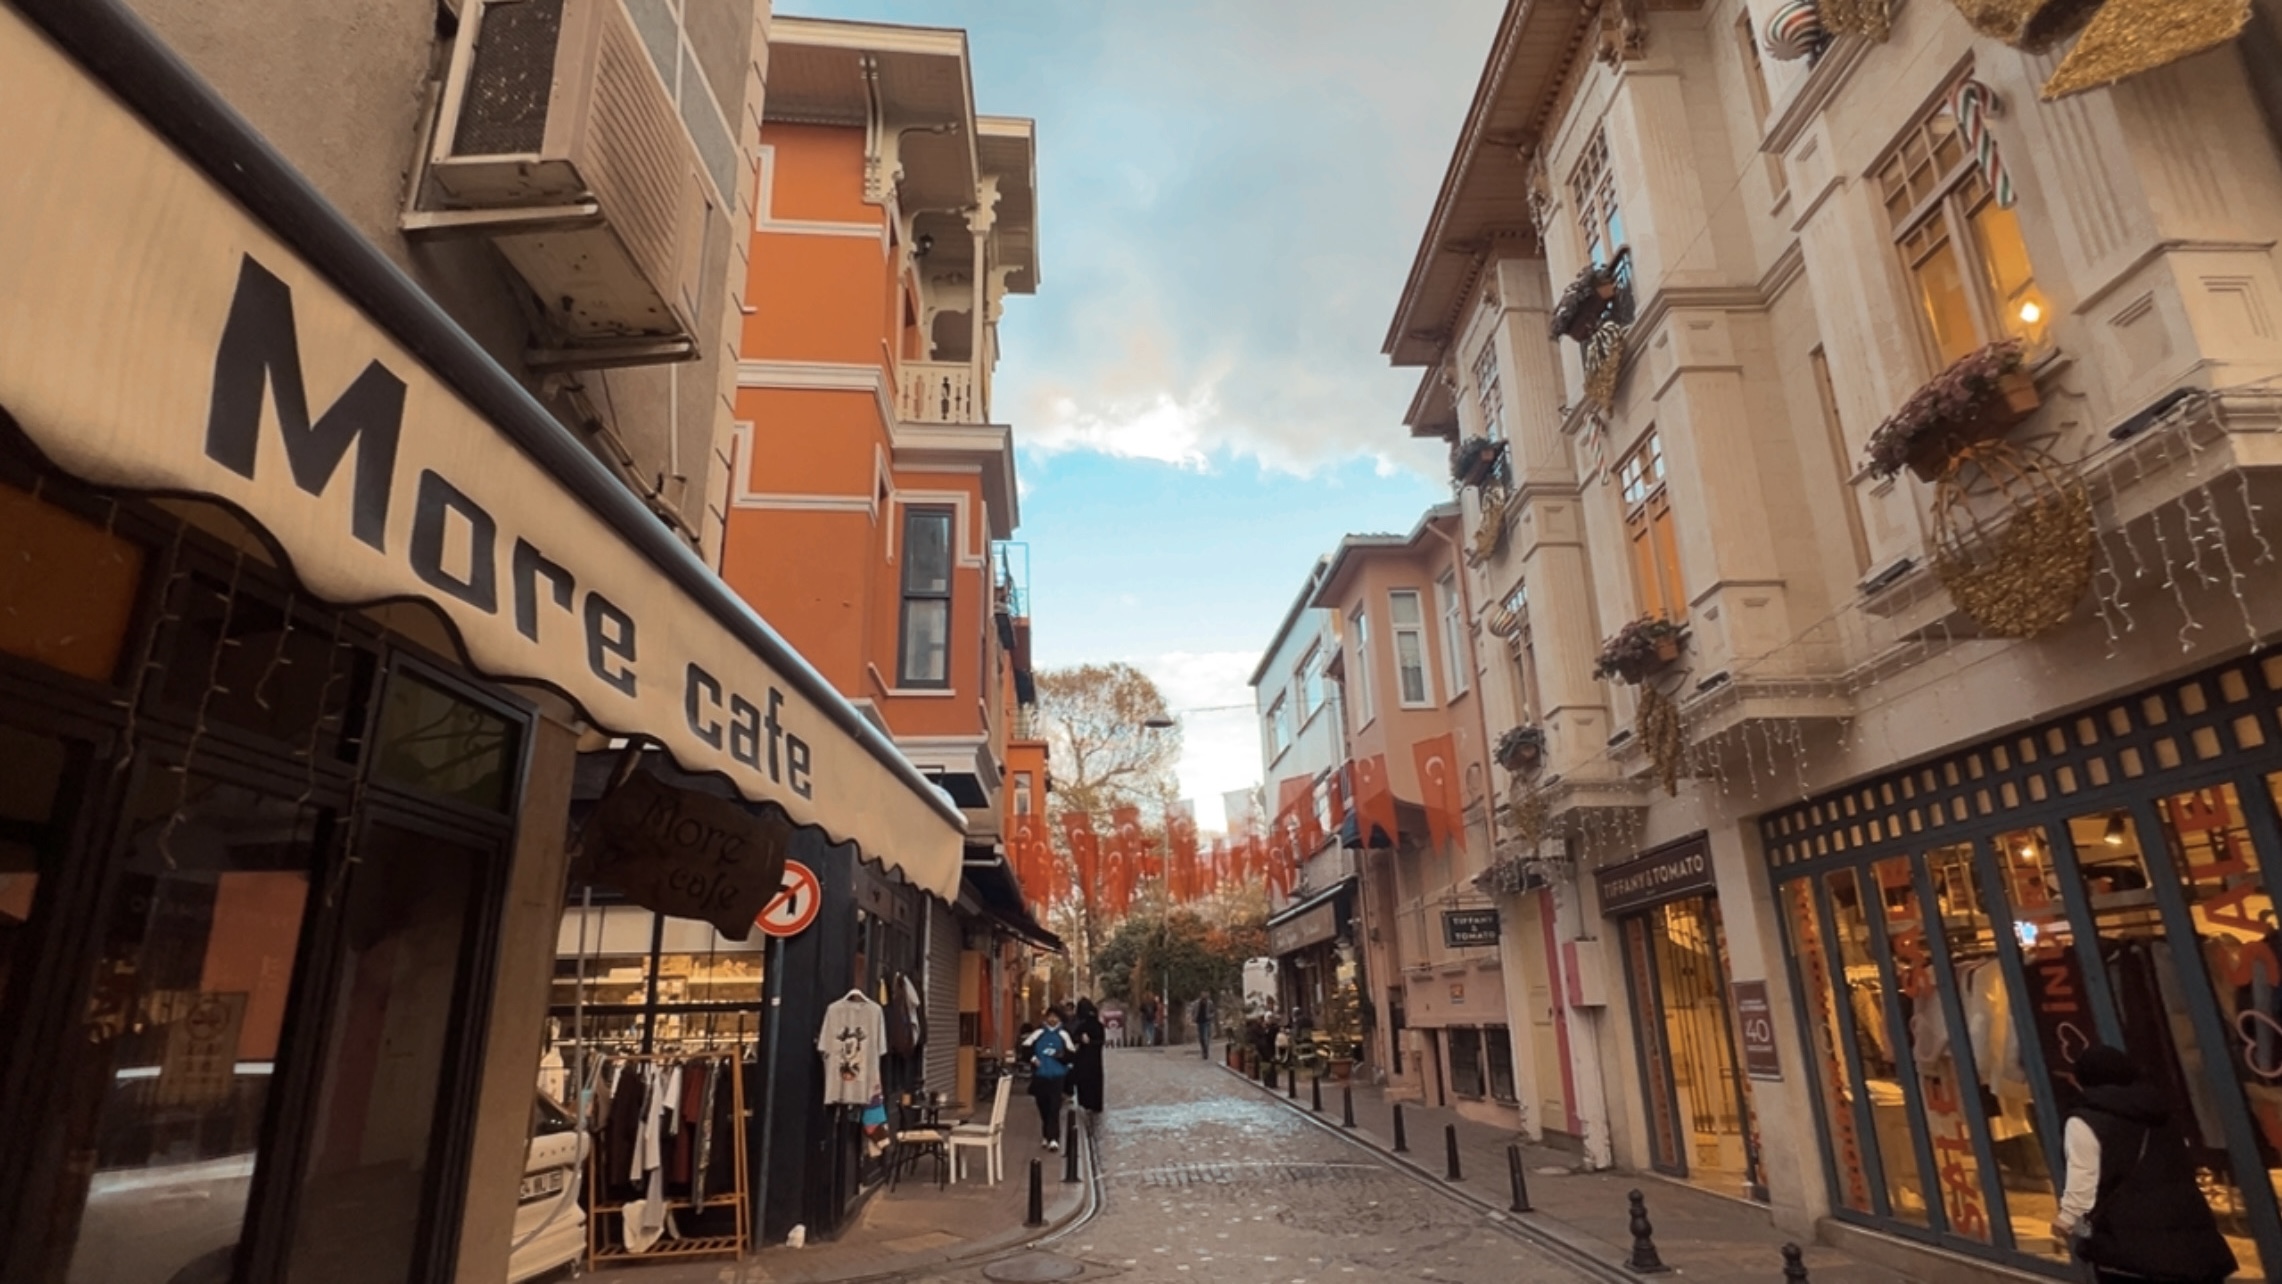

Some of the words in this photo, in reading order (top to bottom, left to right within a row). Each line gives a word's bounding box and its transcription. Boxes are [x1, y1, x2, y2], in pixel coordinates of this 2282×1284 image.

[204, 251, 637, 699] More
[685, 661, 812, 801] cafe
[638, 795, 746, 866] More
[668, 867, 739, 910] cafe
[2169, 784, 2281, 989] SALE
[1745, 1019, 1770, 1042] 40
[1923, 1072, 1986, 1242] SALE
